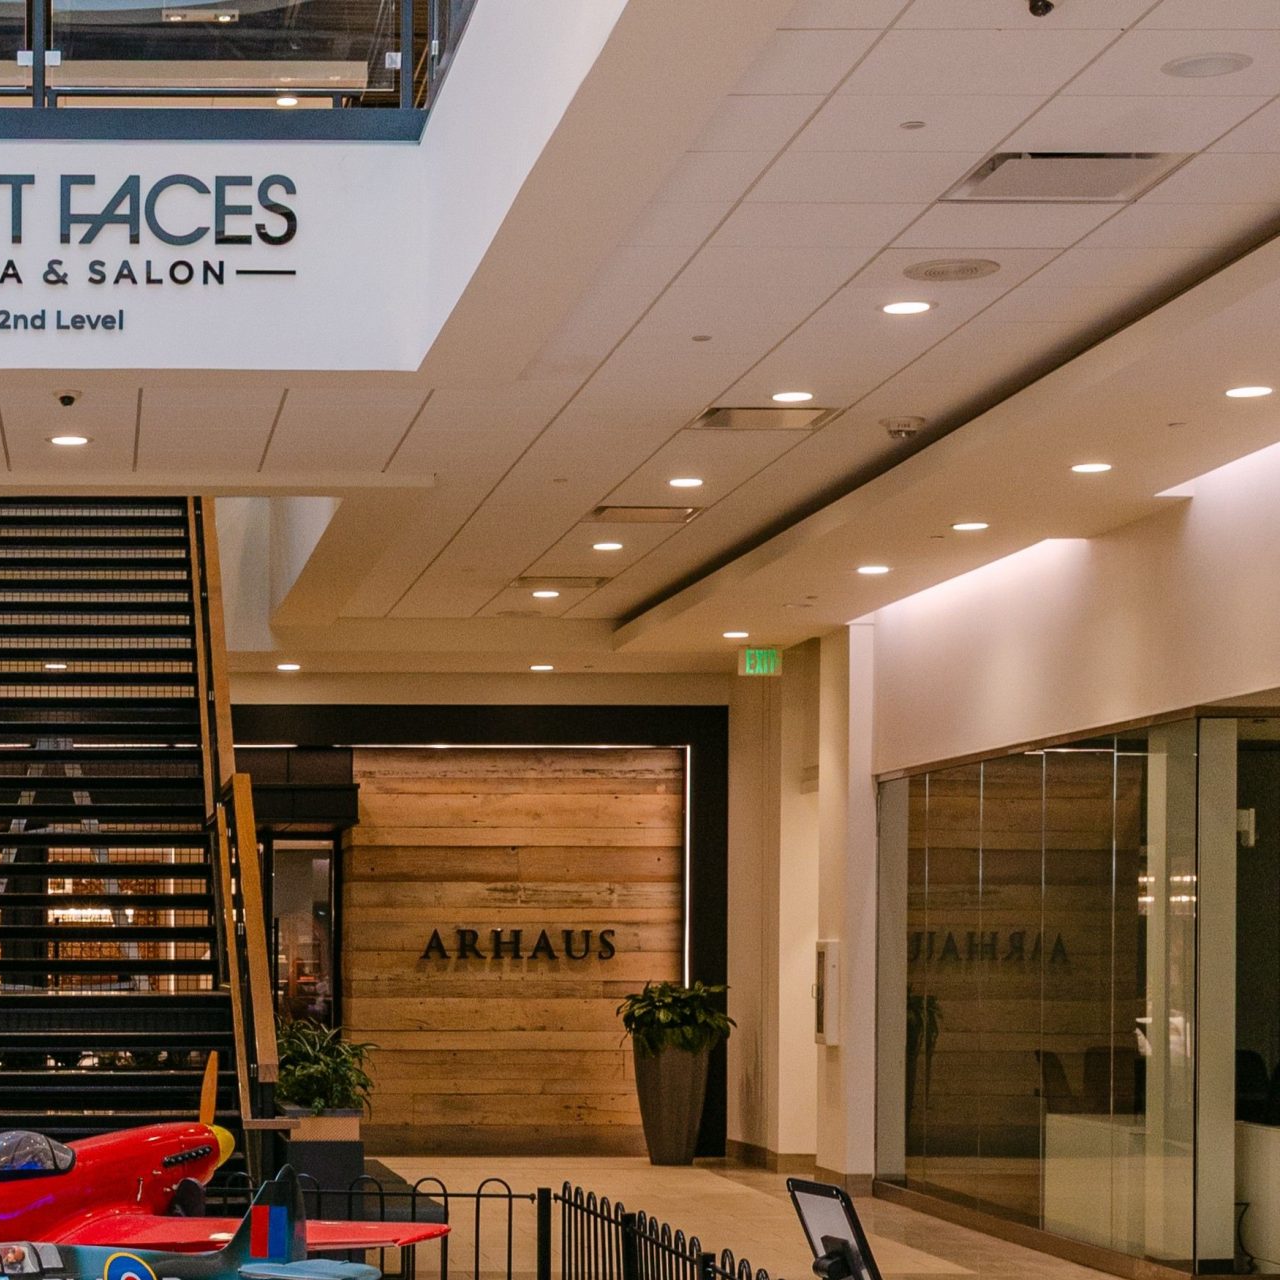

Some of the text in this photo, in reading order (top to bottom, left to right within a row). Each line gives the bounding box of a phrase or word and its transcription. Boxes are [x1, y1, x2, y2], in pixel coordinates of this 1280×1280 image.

[59, 173, 297, 246] FACES
[42, 259, 69, 285] &
[87, 259, 225, 285] SALON
[56, 309, 124, 331] Level
[746, 648, 776, 673] EXIT
[421, 928, 617, 961] ARHAUS
